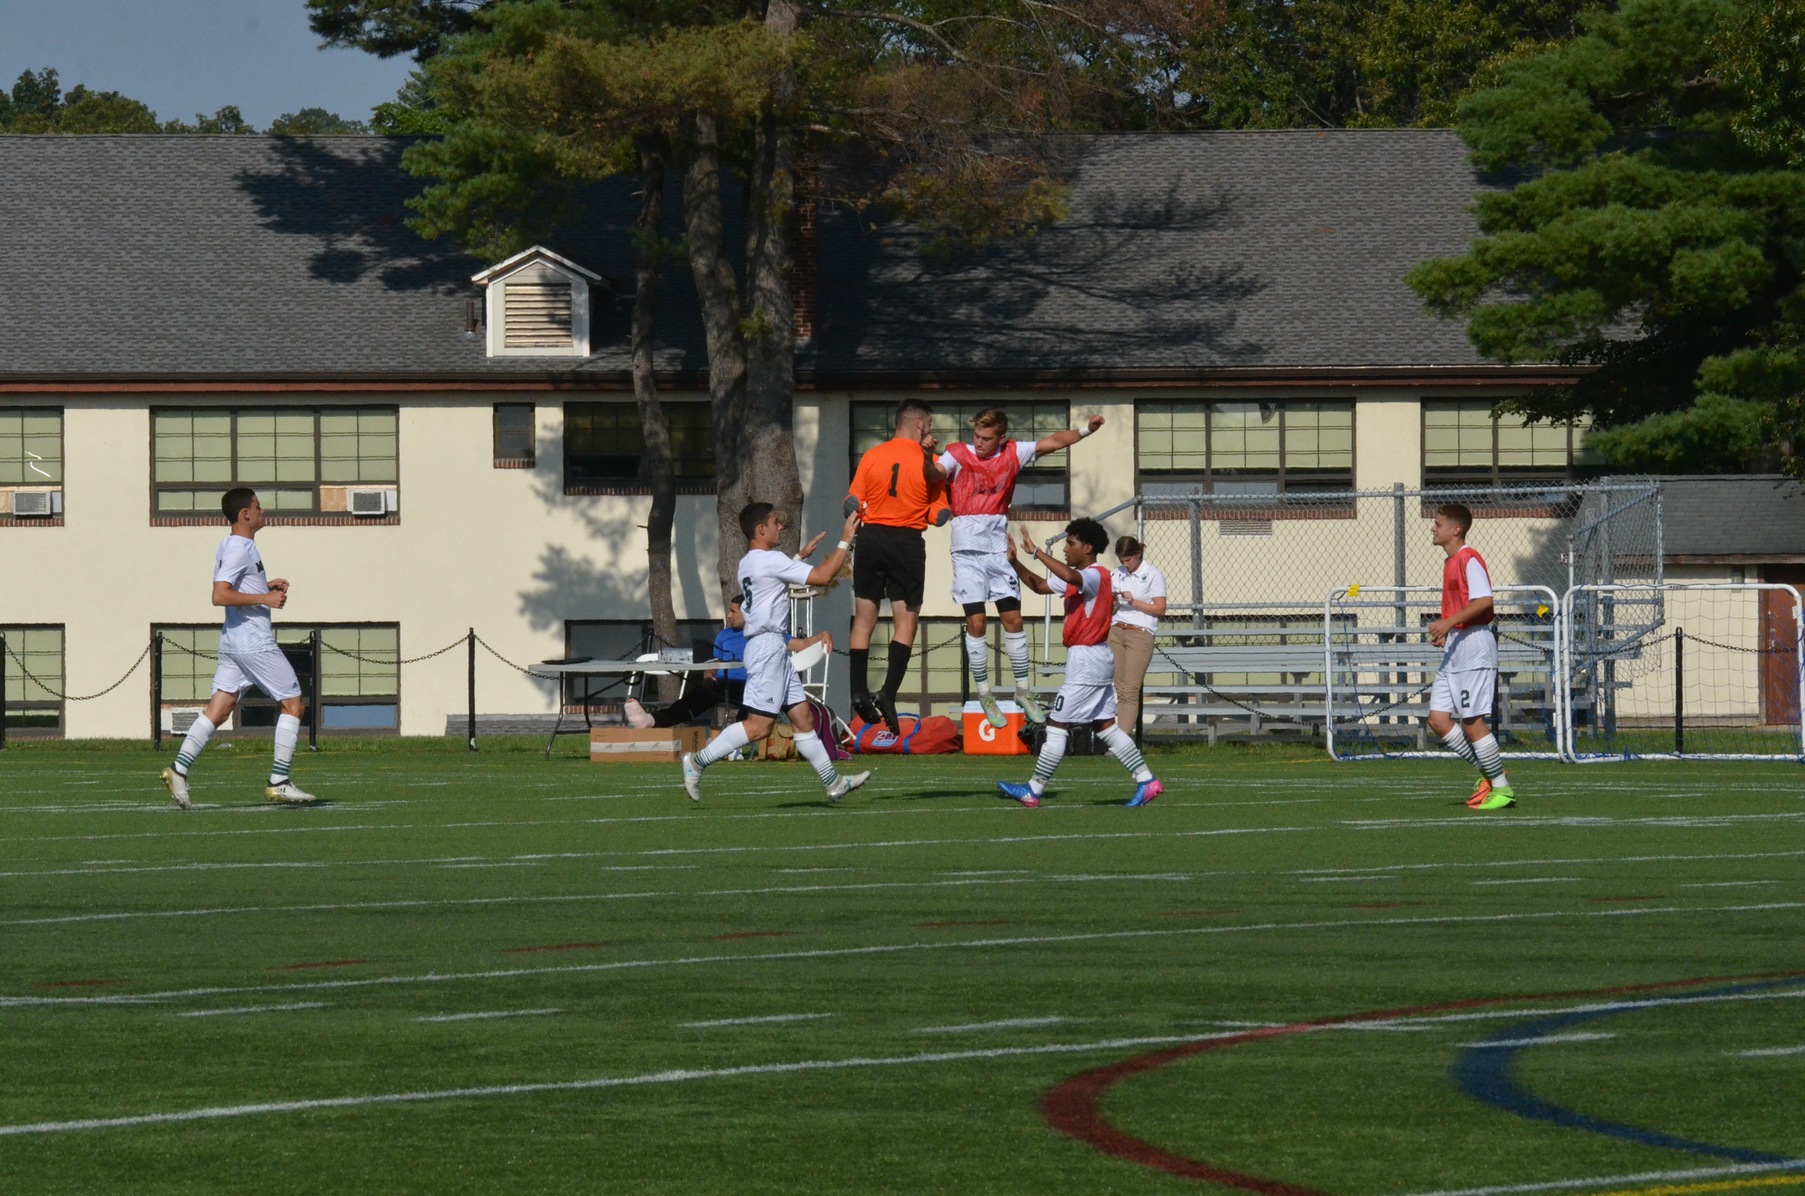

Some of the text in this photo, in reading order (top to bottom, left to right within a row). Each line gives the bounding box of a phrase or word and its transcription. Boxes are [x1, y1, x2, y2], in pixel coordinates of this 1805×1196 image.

[888, 462, 900, 497] 1
[1460, 689, 1470, 708] 2
[978, 718, 996, 742] G
